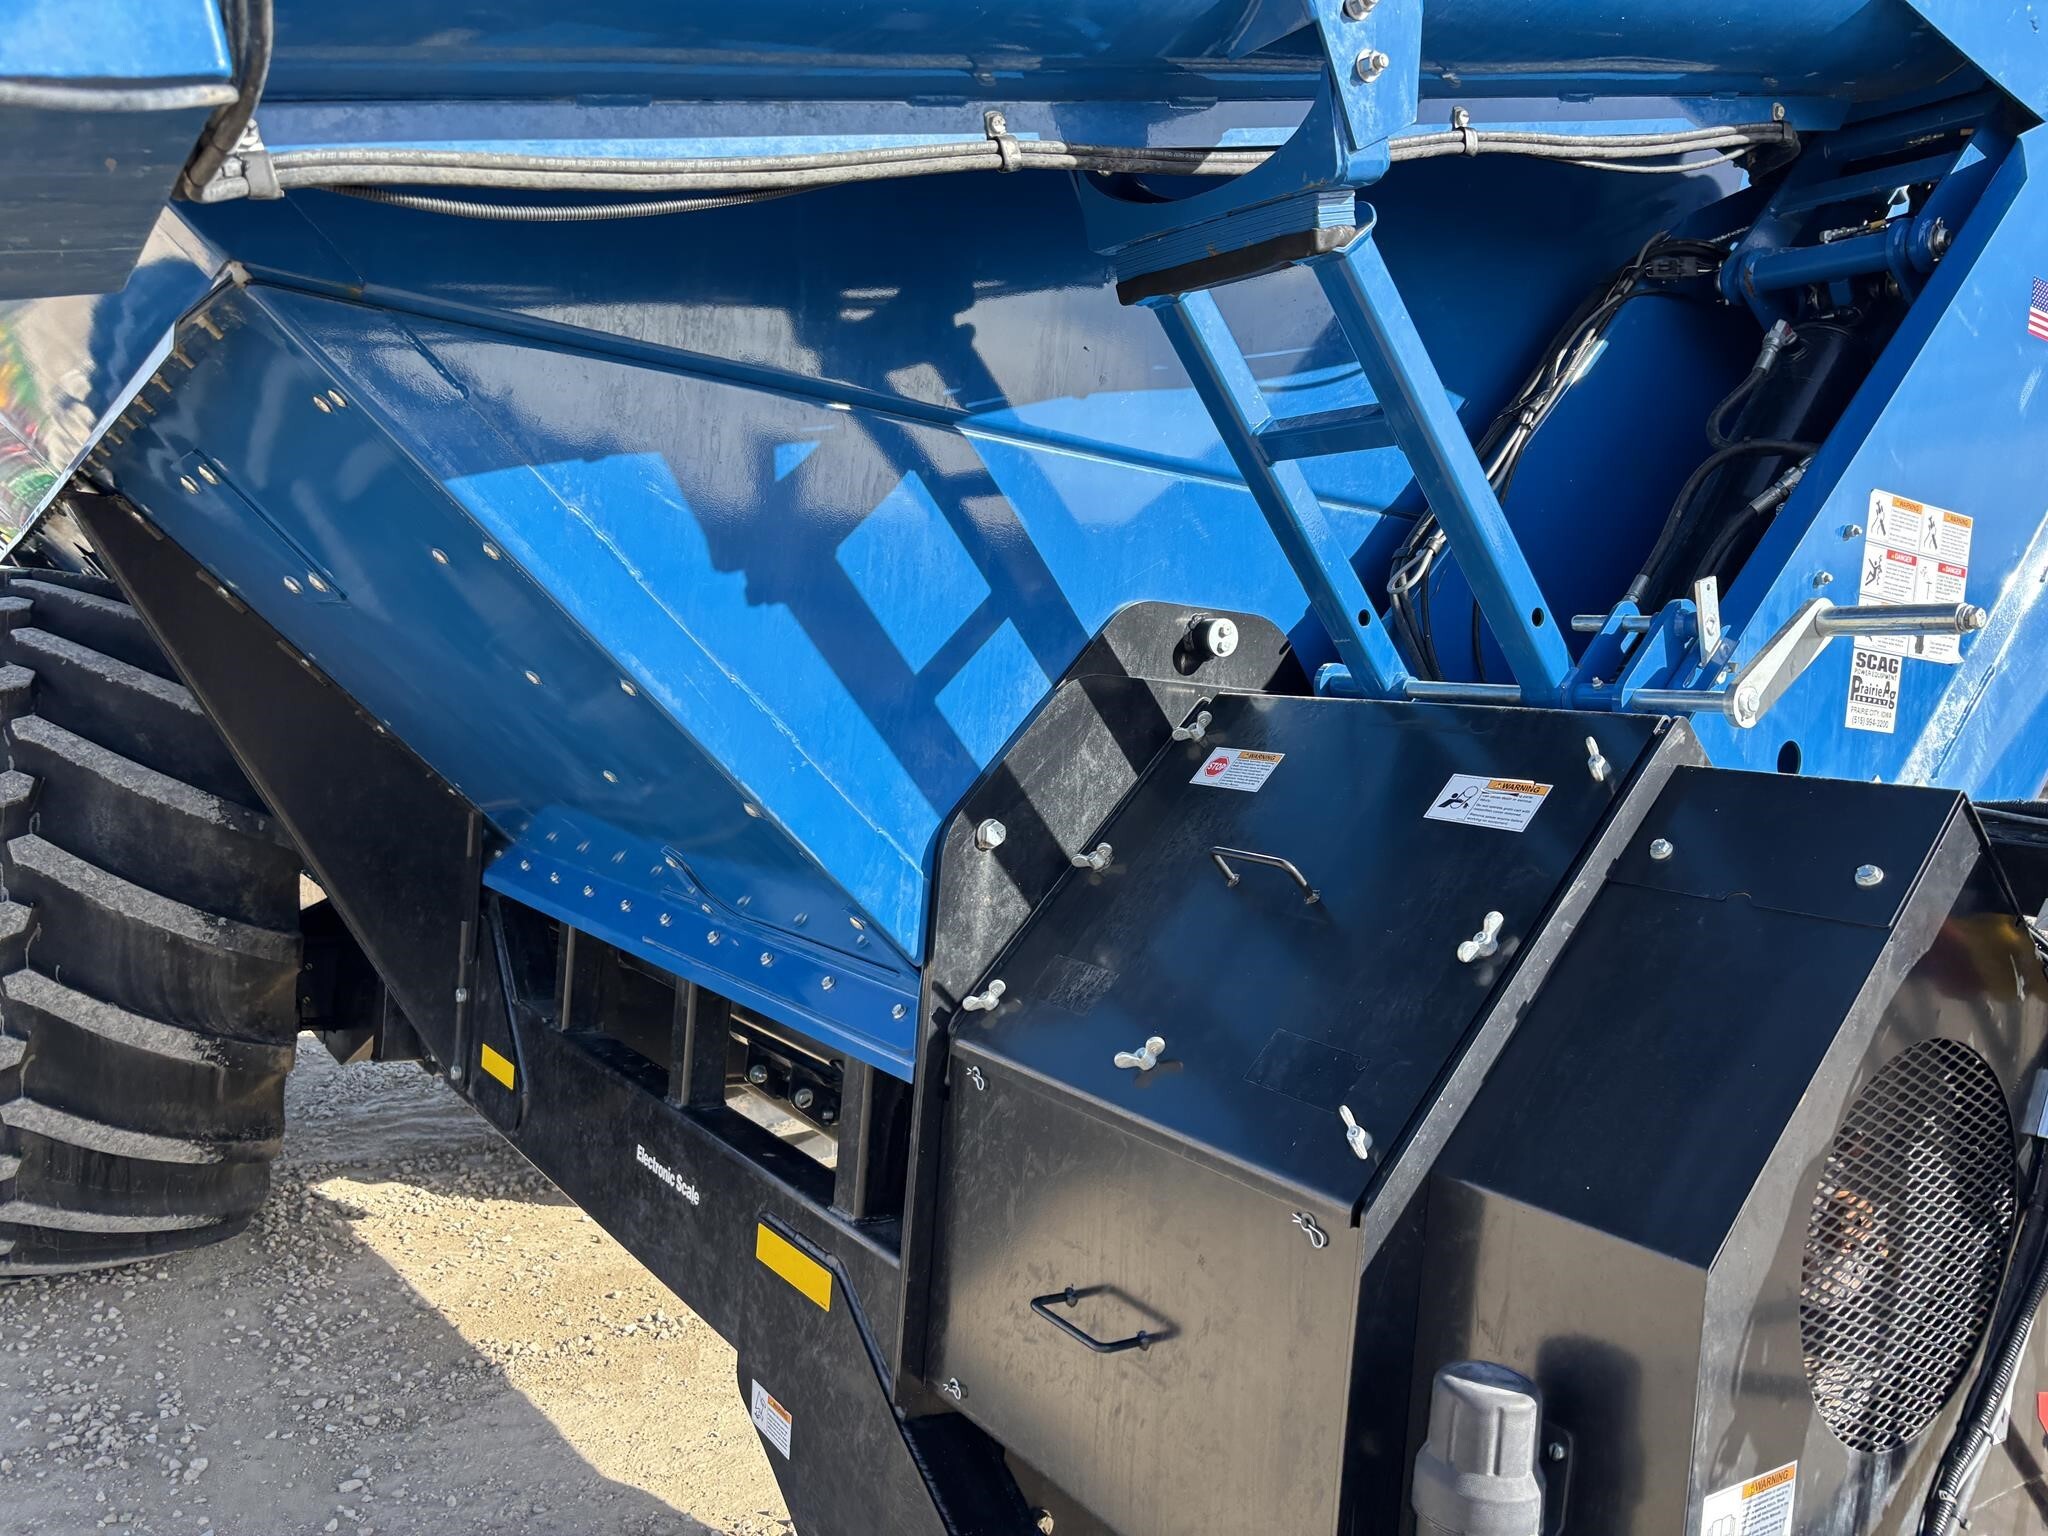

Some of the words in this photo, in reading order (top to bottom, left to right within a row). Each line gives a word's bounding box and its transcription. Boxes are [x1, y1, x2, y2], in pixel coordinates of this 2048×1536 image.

[1894, 551, 1913, 564] DANGER
[1945, 565, 1962, 576] DANGER
[1856, 652, 1899, 674] SCAG
[1207, 762, 1227, 771] STOP
[1502, 782, 1541, 794] WARNING
[636, 1144, 675, 1187] Electronic
[676, 1174, 700, 1205] Scale
[1754, 1469, 1789, 1492] WARNING
